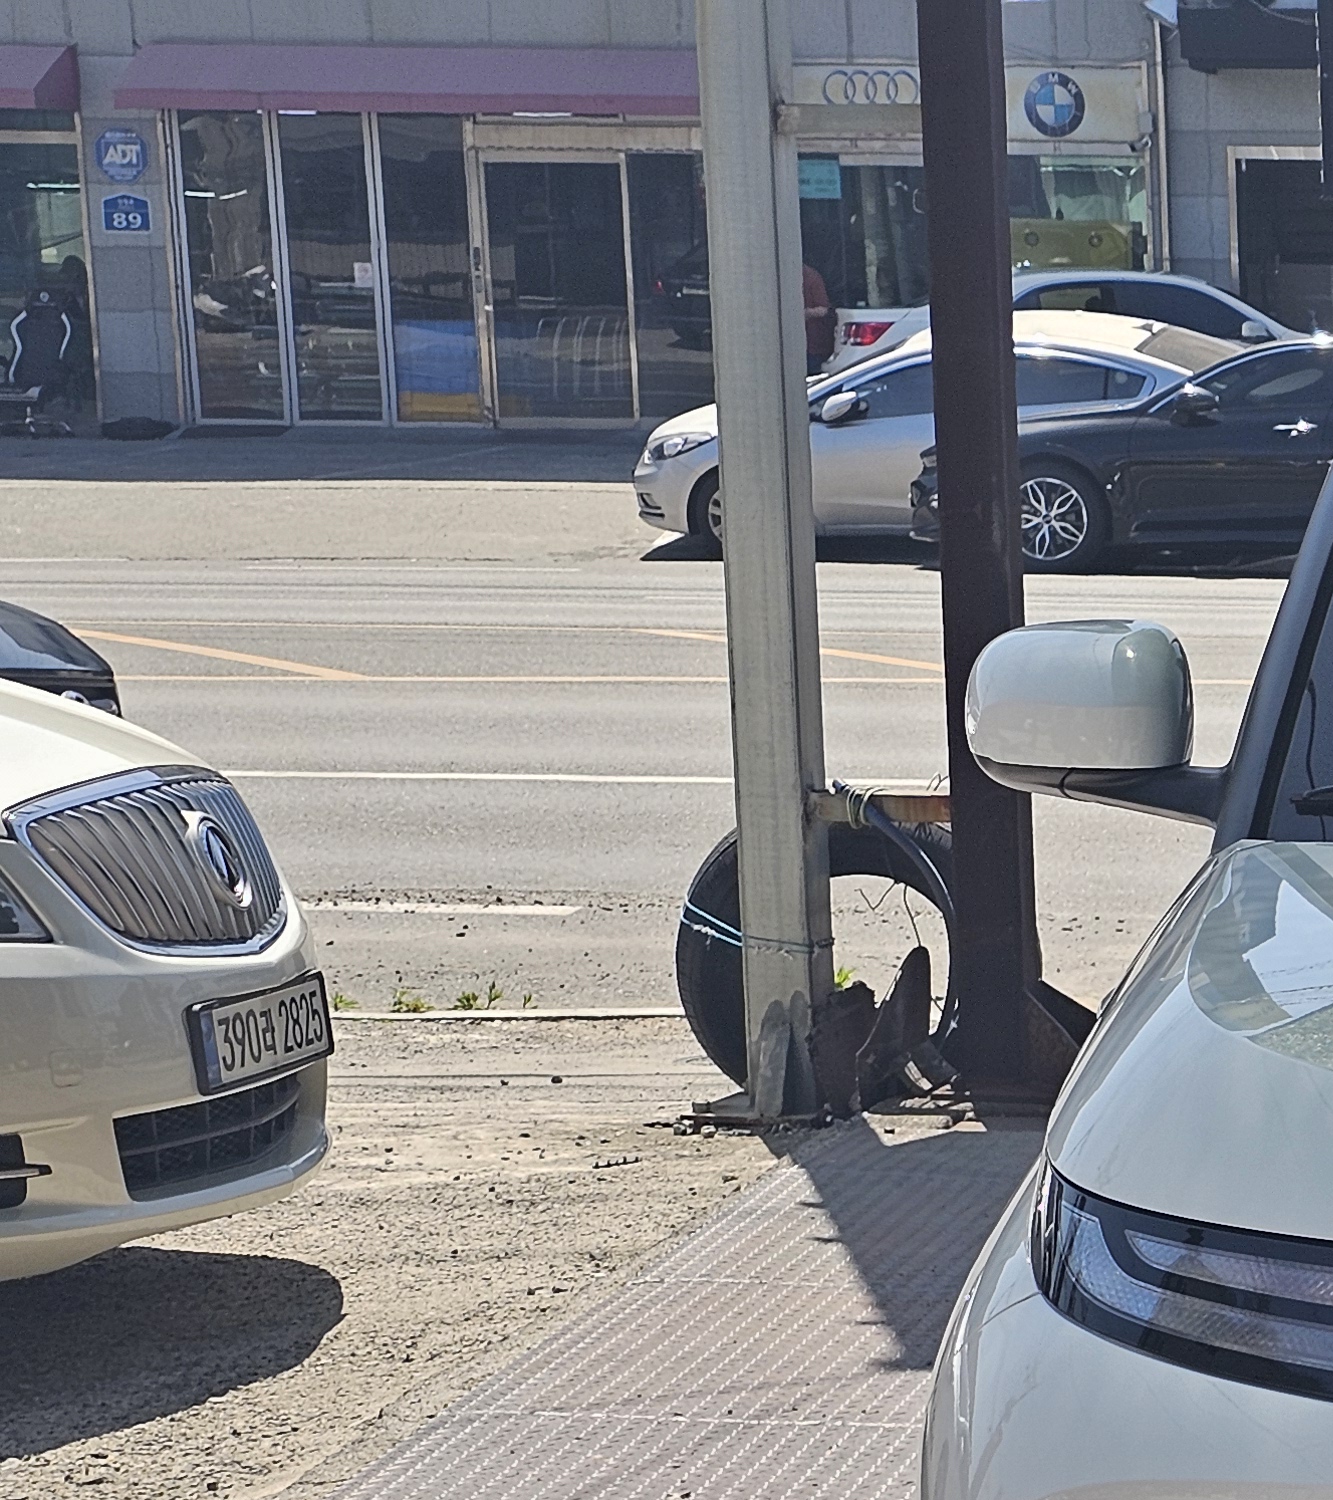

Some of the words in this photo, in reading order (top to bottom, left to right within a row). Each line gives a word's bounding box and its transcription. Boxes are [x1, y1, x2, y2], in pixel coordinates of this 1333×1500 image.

[102, 144, 140, 165] ADT
[113, 212, 142, 229] 89
[217, 1008, 277, 1072] 390라
[278, 989, 323, 1055] 2825
